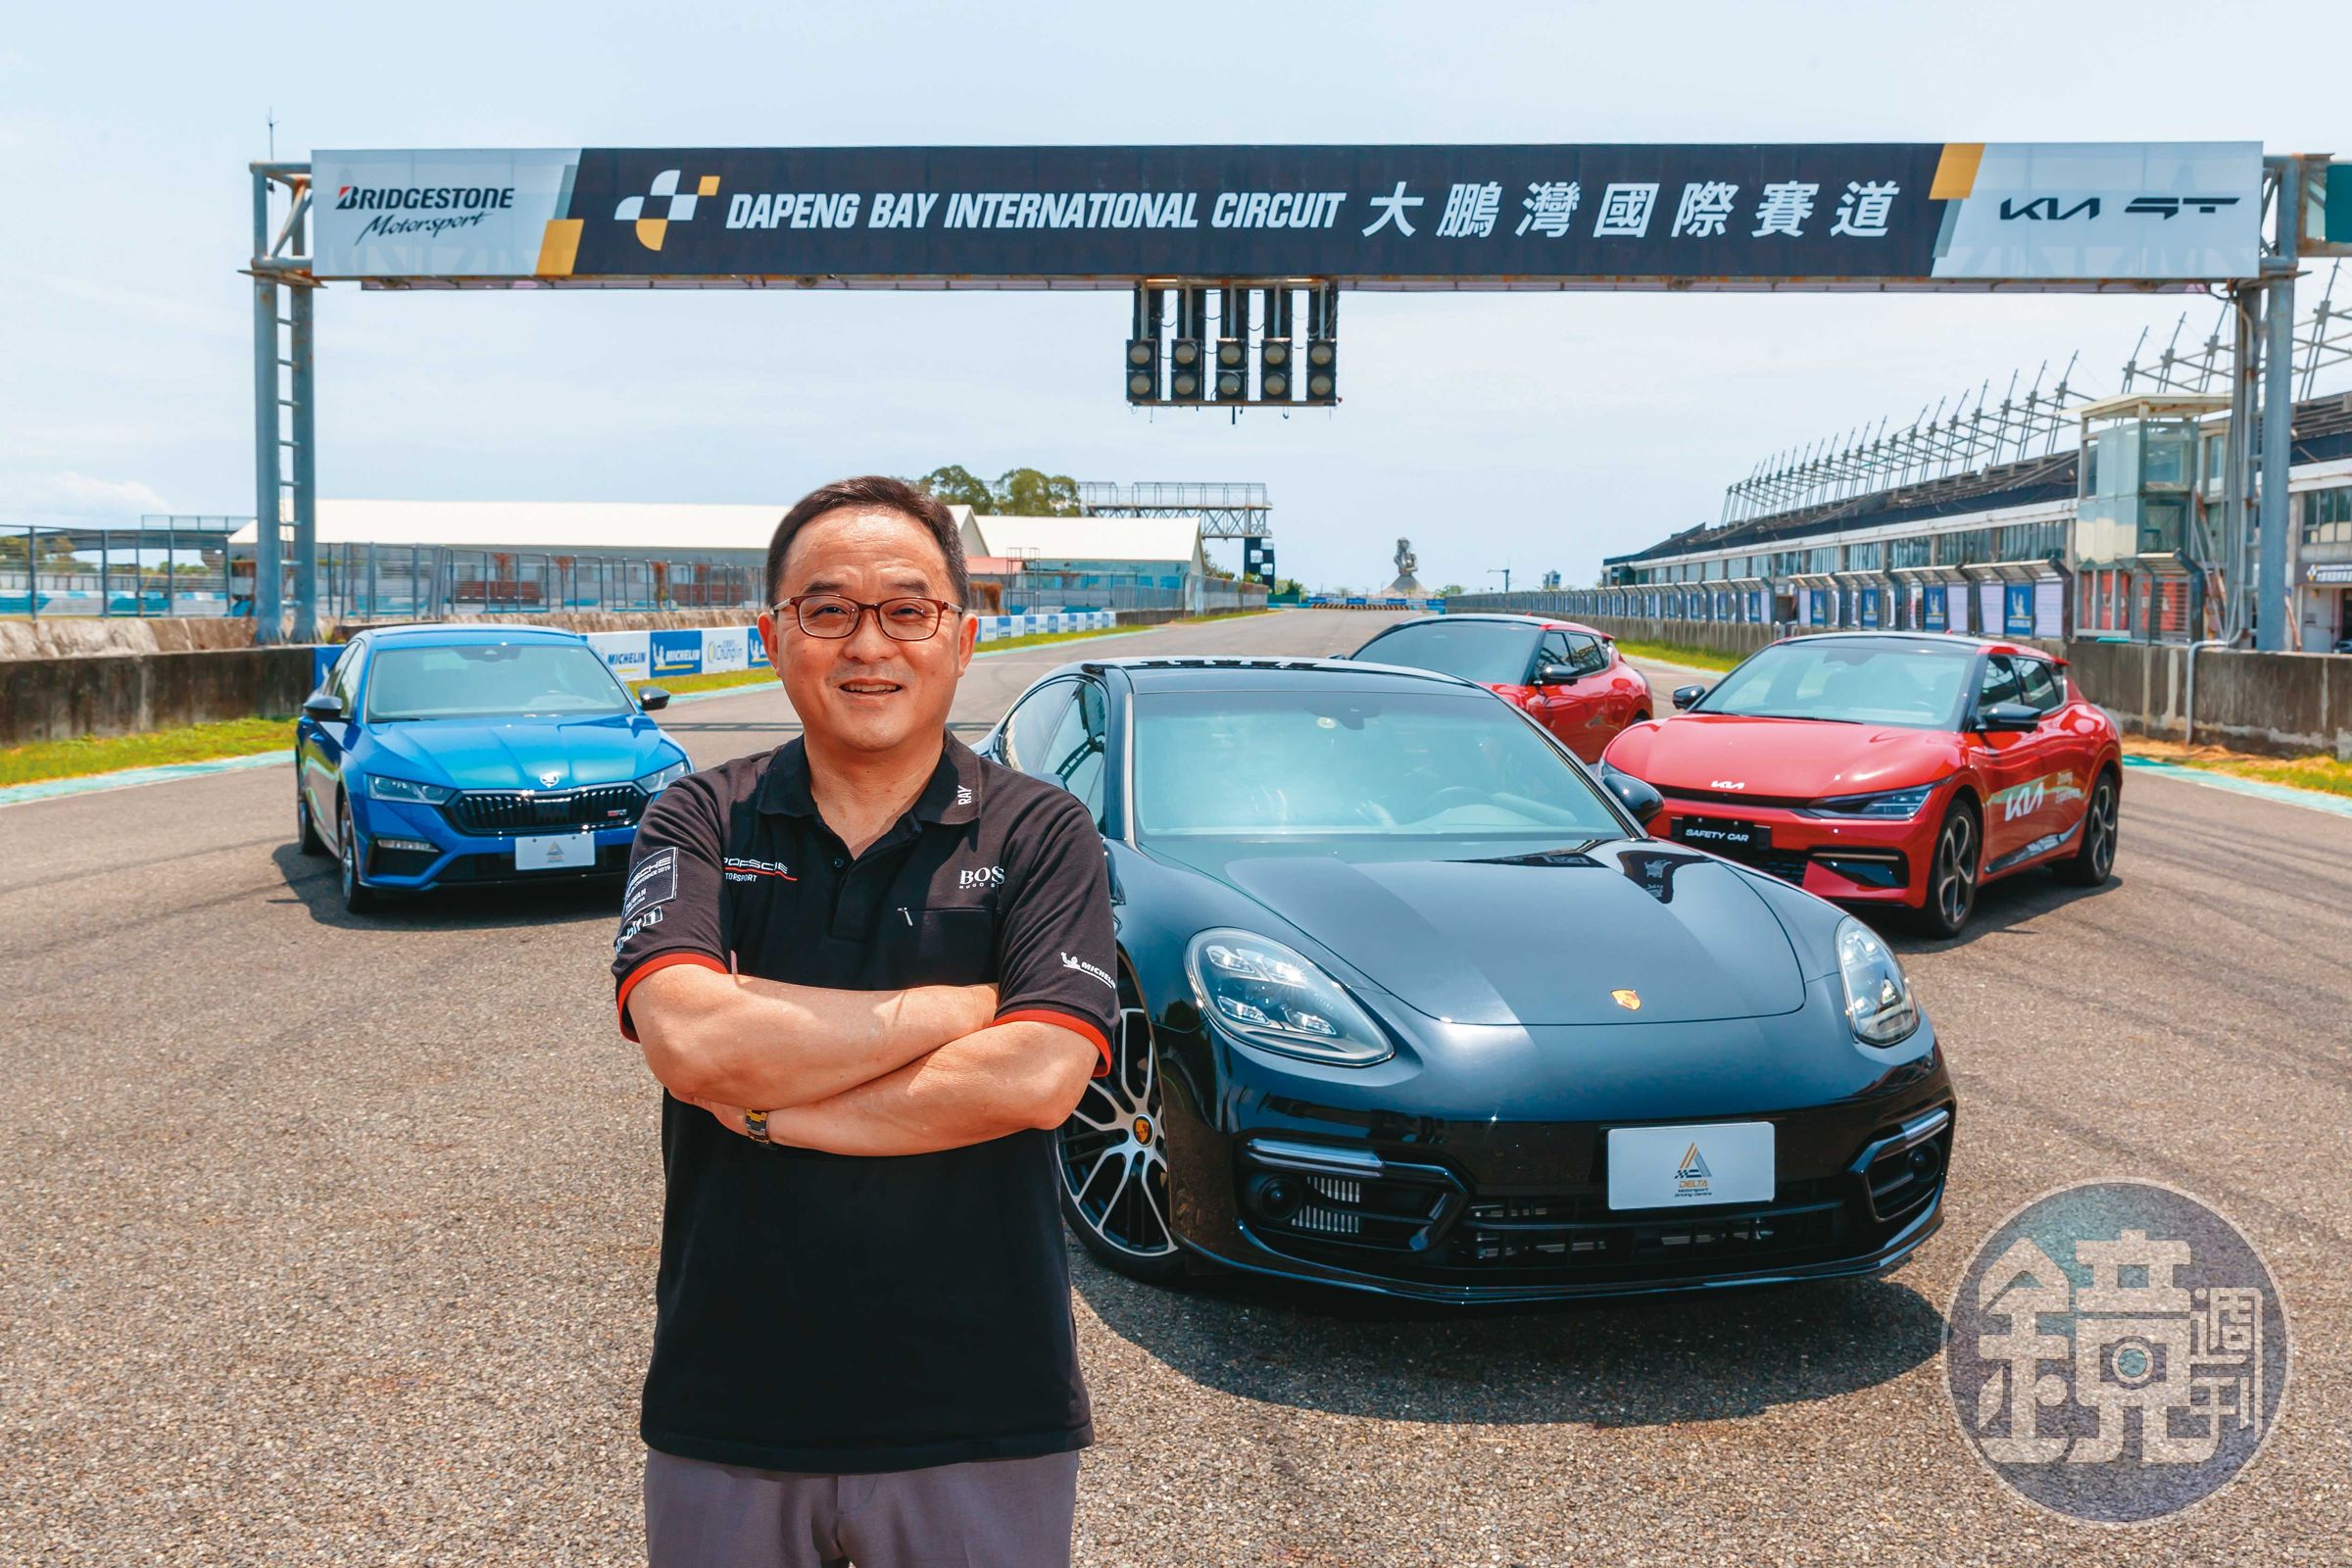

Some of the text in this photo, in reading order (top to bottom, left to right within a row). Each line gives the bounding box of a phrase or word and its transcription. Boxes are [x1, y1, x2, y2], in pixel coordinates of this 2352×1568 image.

[336, 186, 515, 210] BRIDGESTONE
[1361, 180, 1900, 239] 大鵬灣國際賽道
[2000, 197, 2100, 220] KIA
[725, 192, 1347, 229] DAPENG BAY INTERNATIONAL CIRCUIT
[354, 211, 493, 246] Motorsport
[608, 652, 647, 665] MICHELIN
[665, 650, 701, 662] MICHELIN
[957, 785, 972, 805] RAY
[1710, 780, 1745, 790] KIA
[2004, 781, 2044, 822] KIA
[1686, 828, 1749, 842] SAFETY CAR
